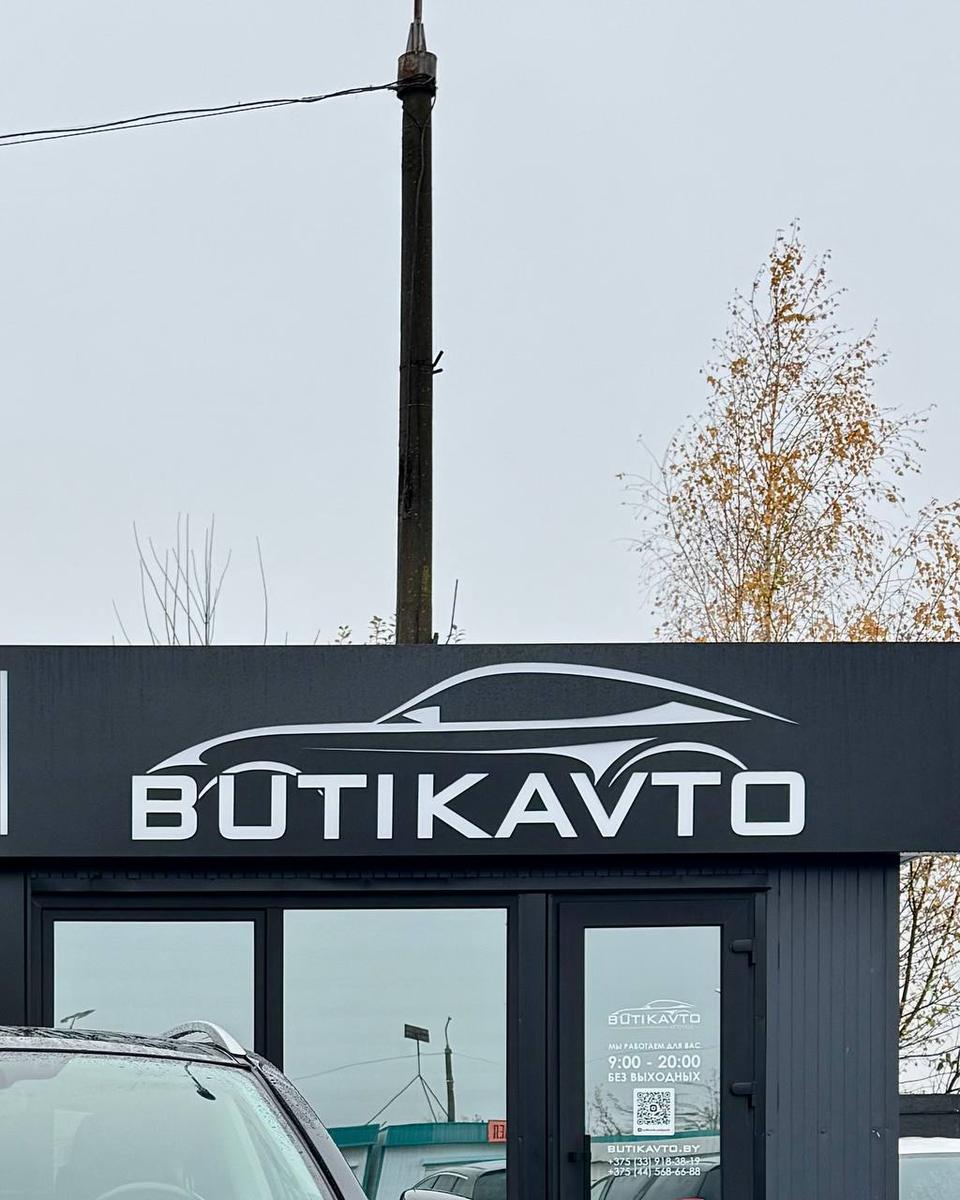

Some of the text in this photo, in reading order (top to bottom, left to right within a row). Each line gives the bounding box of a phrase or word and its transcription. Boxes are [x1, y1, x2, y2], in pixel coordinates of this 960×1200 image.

[131, 770, 807, 841] BUTIKAVTO
[608, 1013, 701, 1025] BUTIKAVTO
[684, 1041, 701, 1049] ВАС
[608, 1056, 641, 1069] 9:00
[658, 1055, 701, 1069] 20:00
[608, 1072, 701, 1083] БЕЗ ВЫХОДНЫХ
[607, 1145, 701, 1153] BUTIKAVTO.BY
[608, 1157, 701, 1168] +375 (33) 918-38-19
[608, 1167, 701, 1178] +375 (44) 568-66-88
